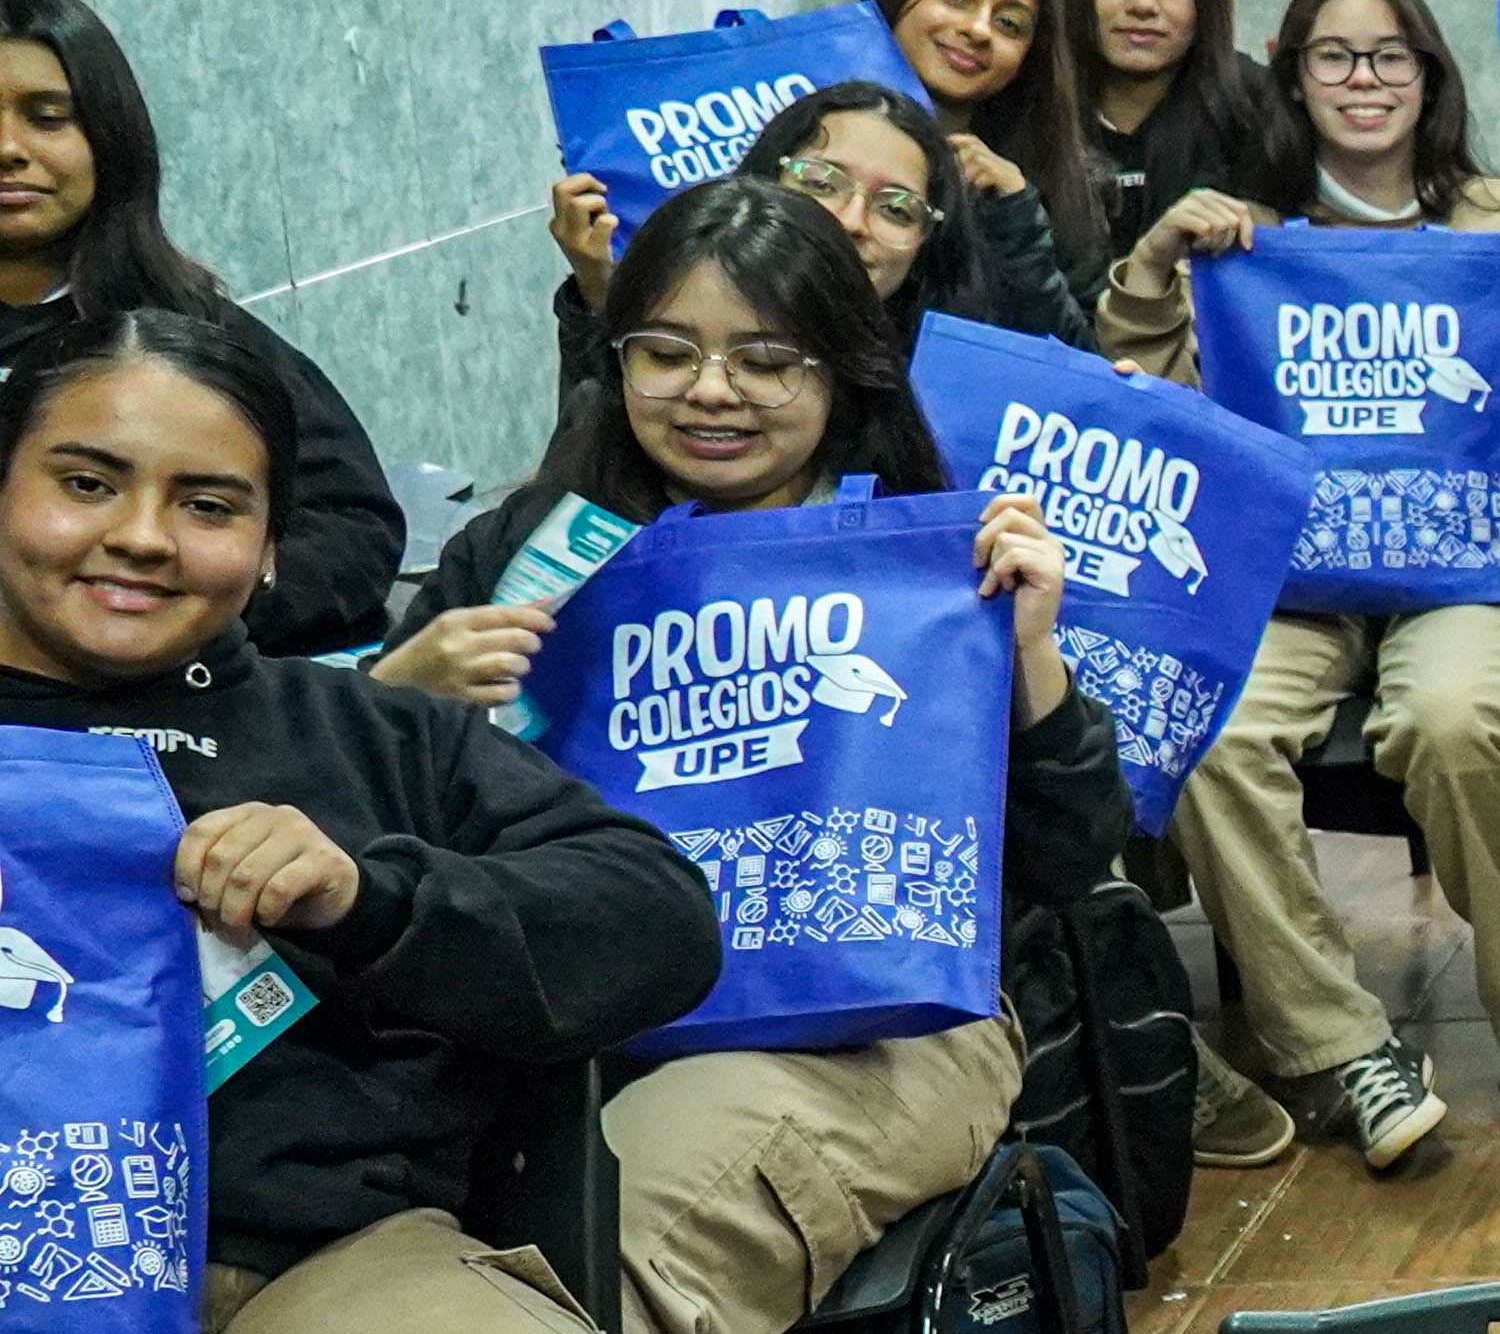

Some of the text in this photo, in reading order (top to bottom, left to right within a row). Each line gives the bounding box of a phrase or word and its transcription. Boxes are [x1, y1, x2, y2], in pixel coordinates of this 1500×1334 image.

[1277, 302, 1460, 359] PROMO
[1327, 405, 1397, 431] UPE
[994, 401, 1200, 523] PROMO
[612, 592, 864, 700] PROMO
[674, 733, 769, 779] UPE
